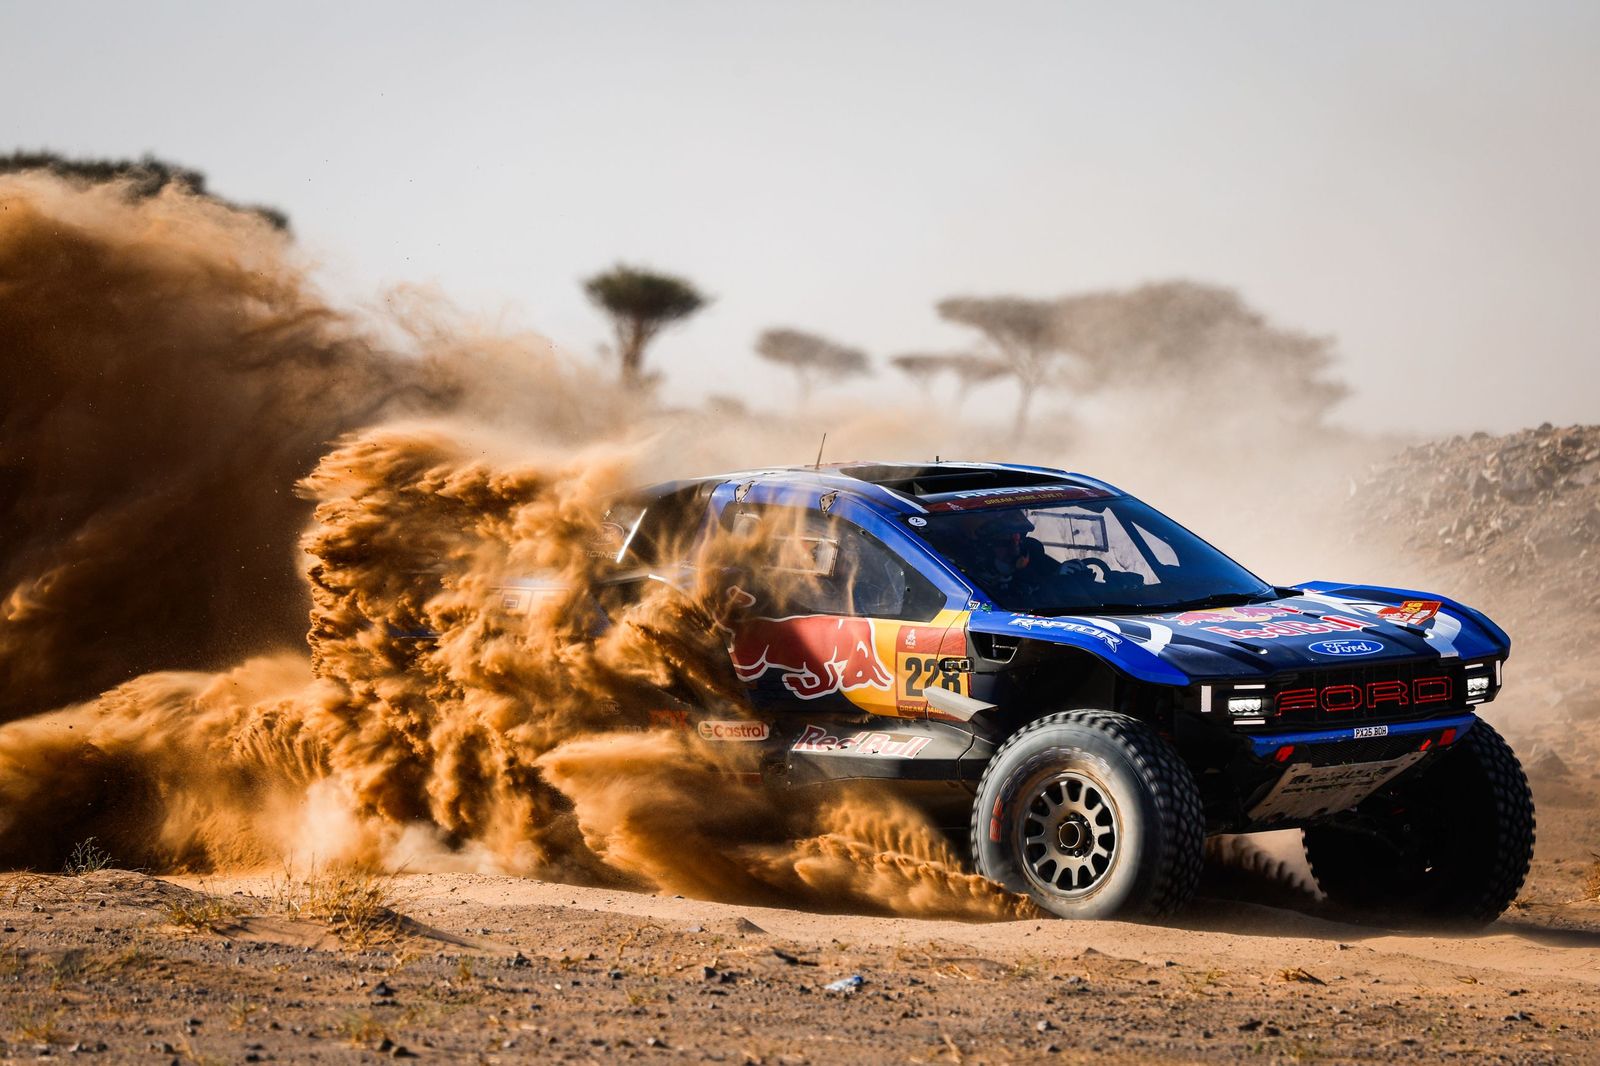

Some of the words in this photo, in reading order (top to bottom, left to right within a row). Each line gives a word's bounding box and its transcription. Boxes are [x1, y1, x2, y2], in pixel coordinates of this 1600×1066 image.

[1008, 617, 1122, 652] RAPTOR
[1325, 640, 1372, 653] Ford
[1274, 676, 1453, 717] FORD
[714, 723, 765, 738] Castrol
[792, 724, 866, 751] Red
[856, 731, 933, 759] Bull
